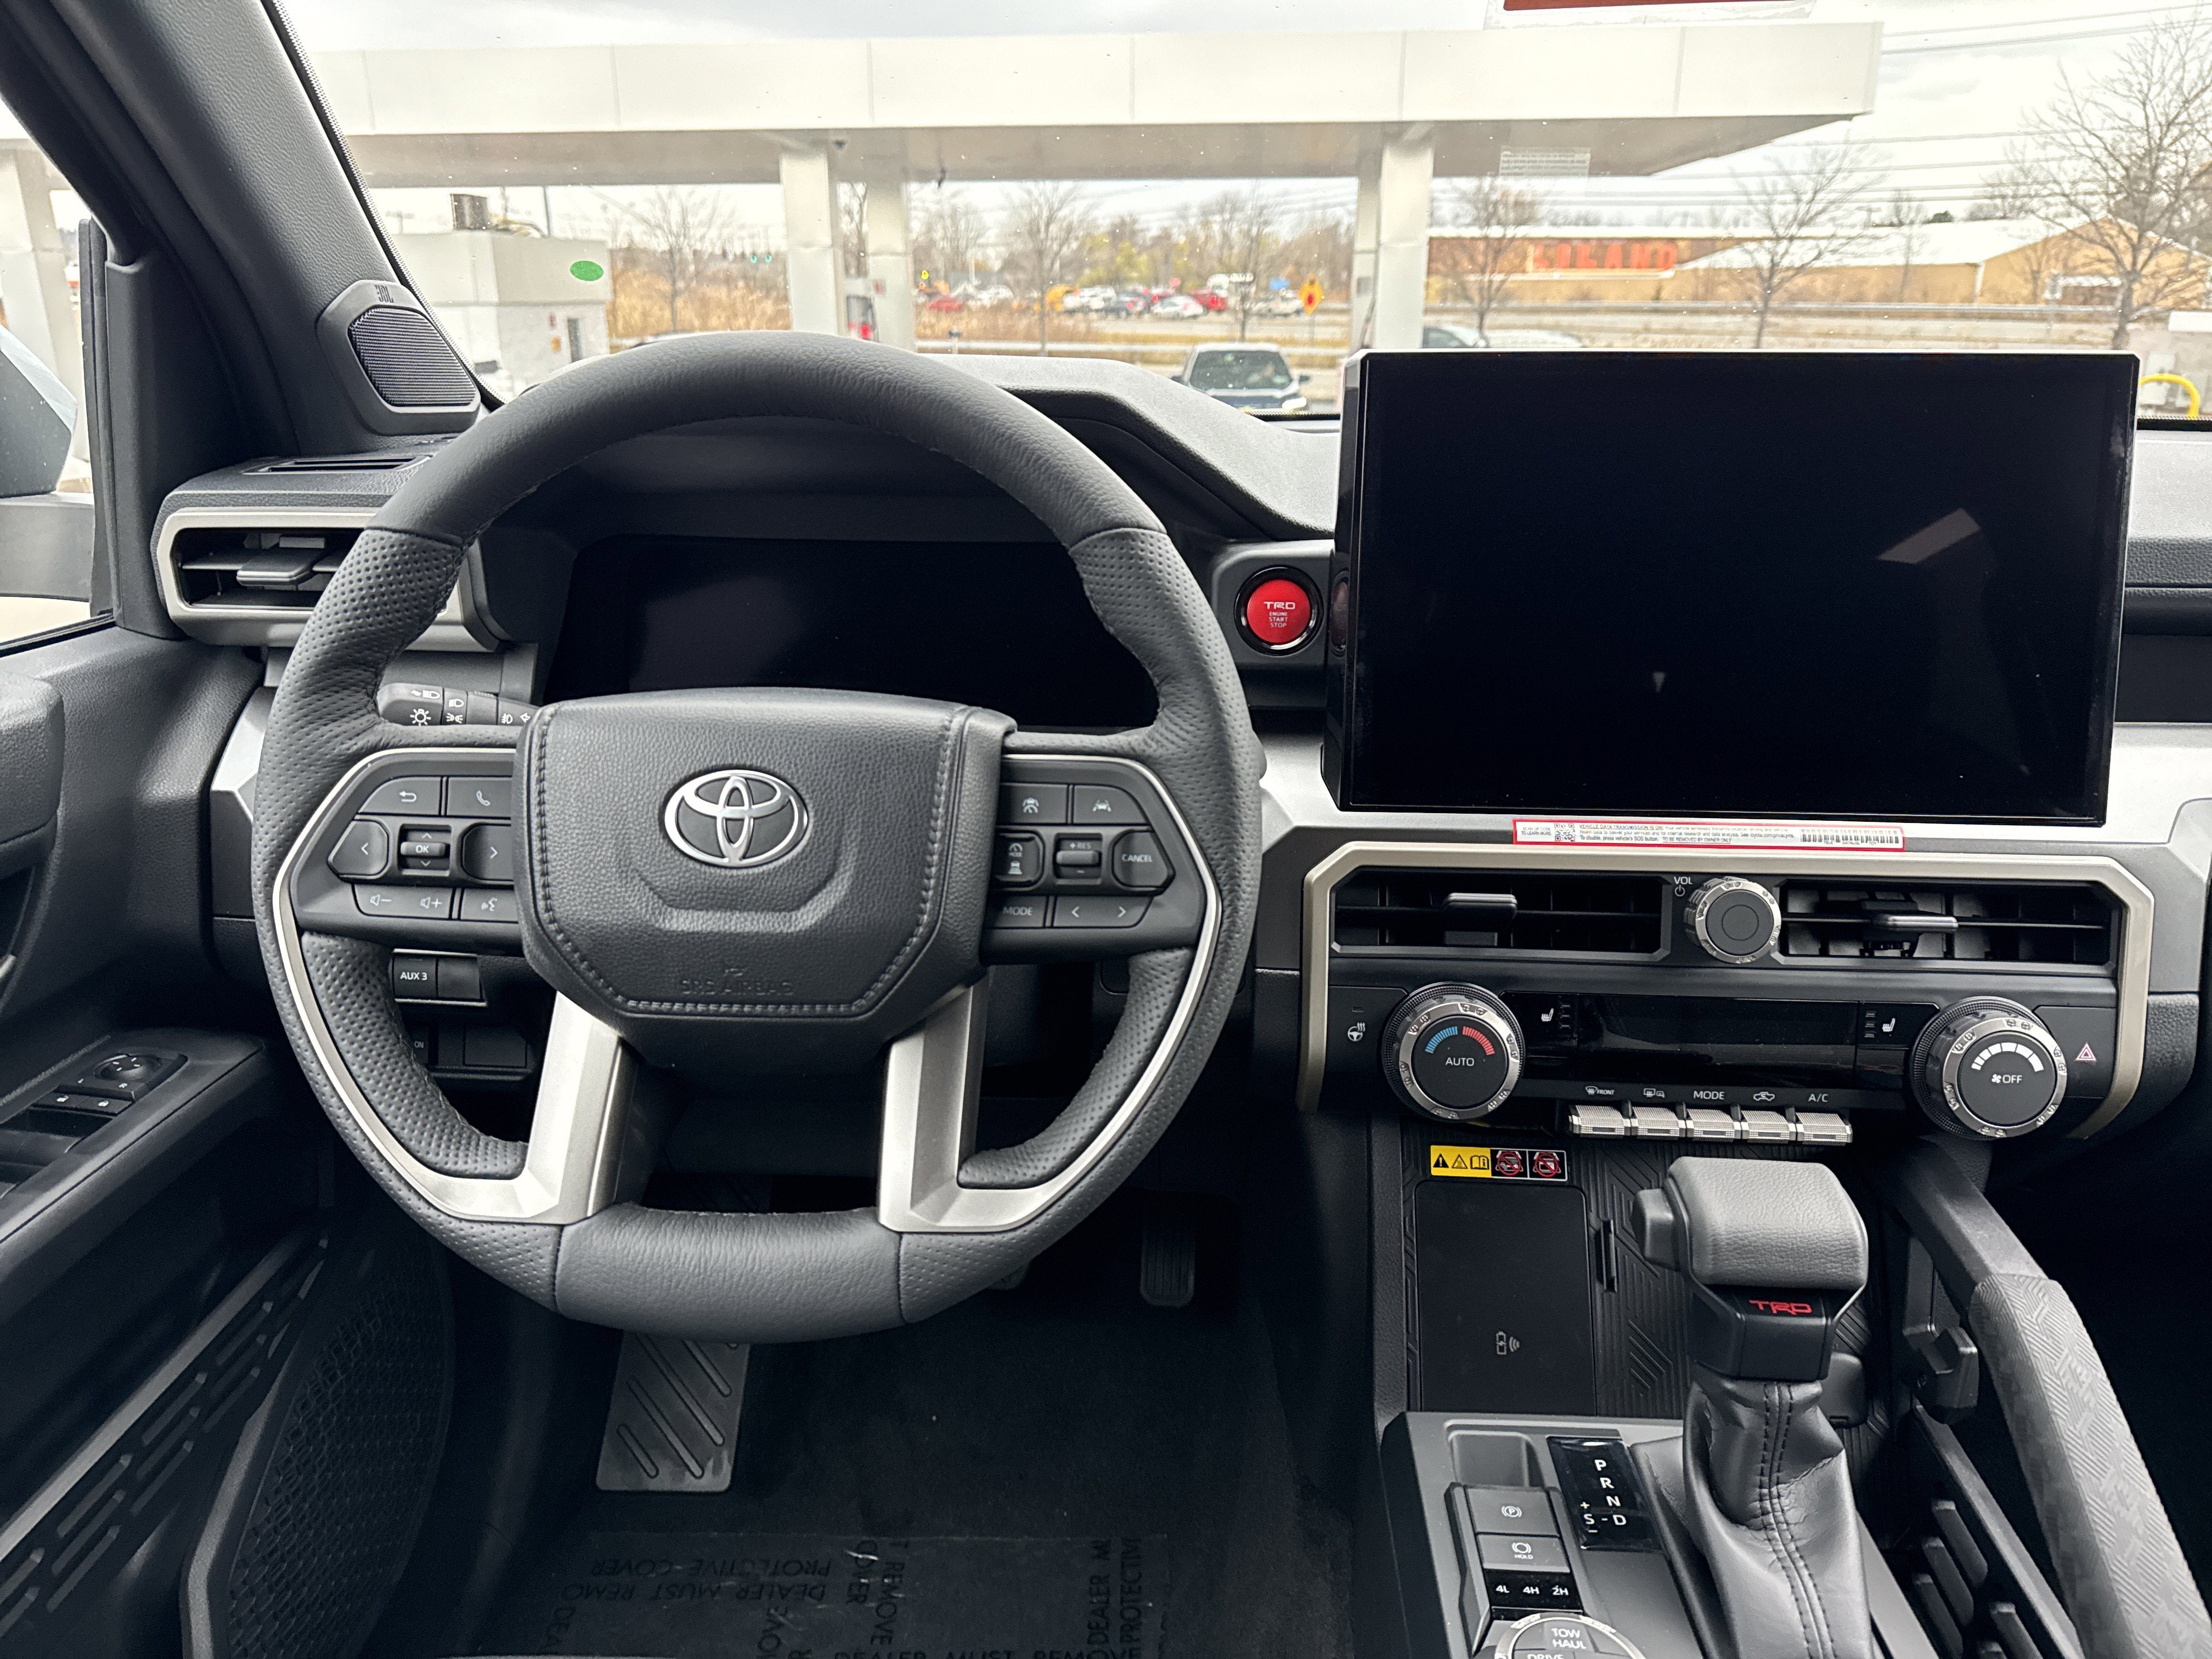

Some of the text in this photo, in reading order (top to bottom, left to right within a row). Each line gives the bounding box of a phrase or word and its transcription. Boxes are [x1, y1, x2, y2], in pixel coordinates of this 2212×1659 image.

[375, 285, 394, 303] JBL
[1263, 601, 1296, 610] TRD
[415, 845, 430, 854] OK
[1121, 854, 1153, 864] CANCEL
[1674, 876, 1692, 885] VOL
[1003, 907, 1033, 916] MODE
[400, 972, 427, 980] AUX 3
[1445, 1057, 1475, 1066] AUTO
[2002, 1074, 2023, 1084] OFF
[1693, 1090, 1725, 1101] MODE
[1809, 1093, 1829, 1103] A/C
[1748, 1300, 1812, 1315] TRD
[1594, 1459, 1607, 1471] P
[1599, 1477, 1615, 1489] R
[1606, 1495, 1621, 1507] N
[1584, 1514, 1627, 1526] S D
[590, 1559, 674, 1577] COVER
[846, 1539, 878, 1605] COVER
[560, 1583, 827, 1601] DEALER MUST REMO
[1496, 1584, 1510, 1594] 4L
[1522, 1585, 1540, 1595] 4H
[1552, 1586, 1568, 1596] 2H
[870, 1561, 905, 1645] REMOVE
[1086, 1573, 1111, 1645] DEALER
[1551, 1628, 1581, 1638] TOW
[1552, 1639, 1587, 1650] HAUL
